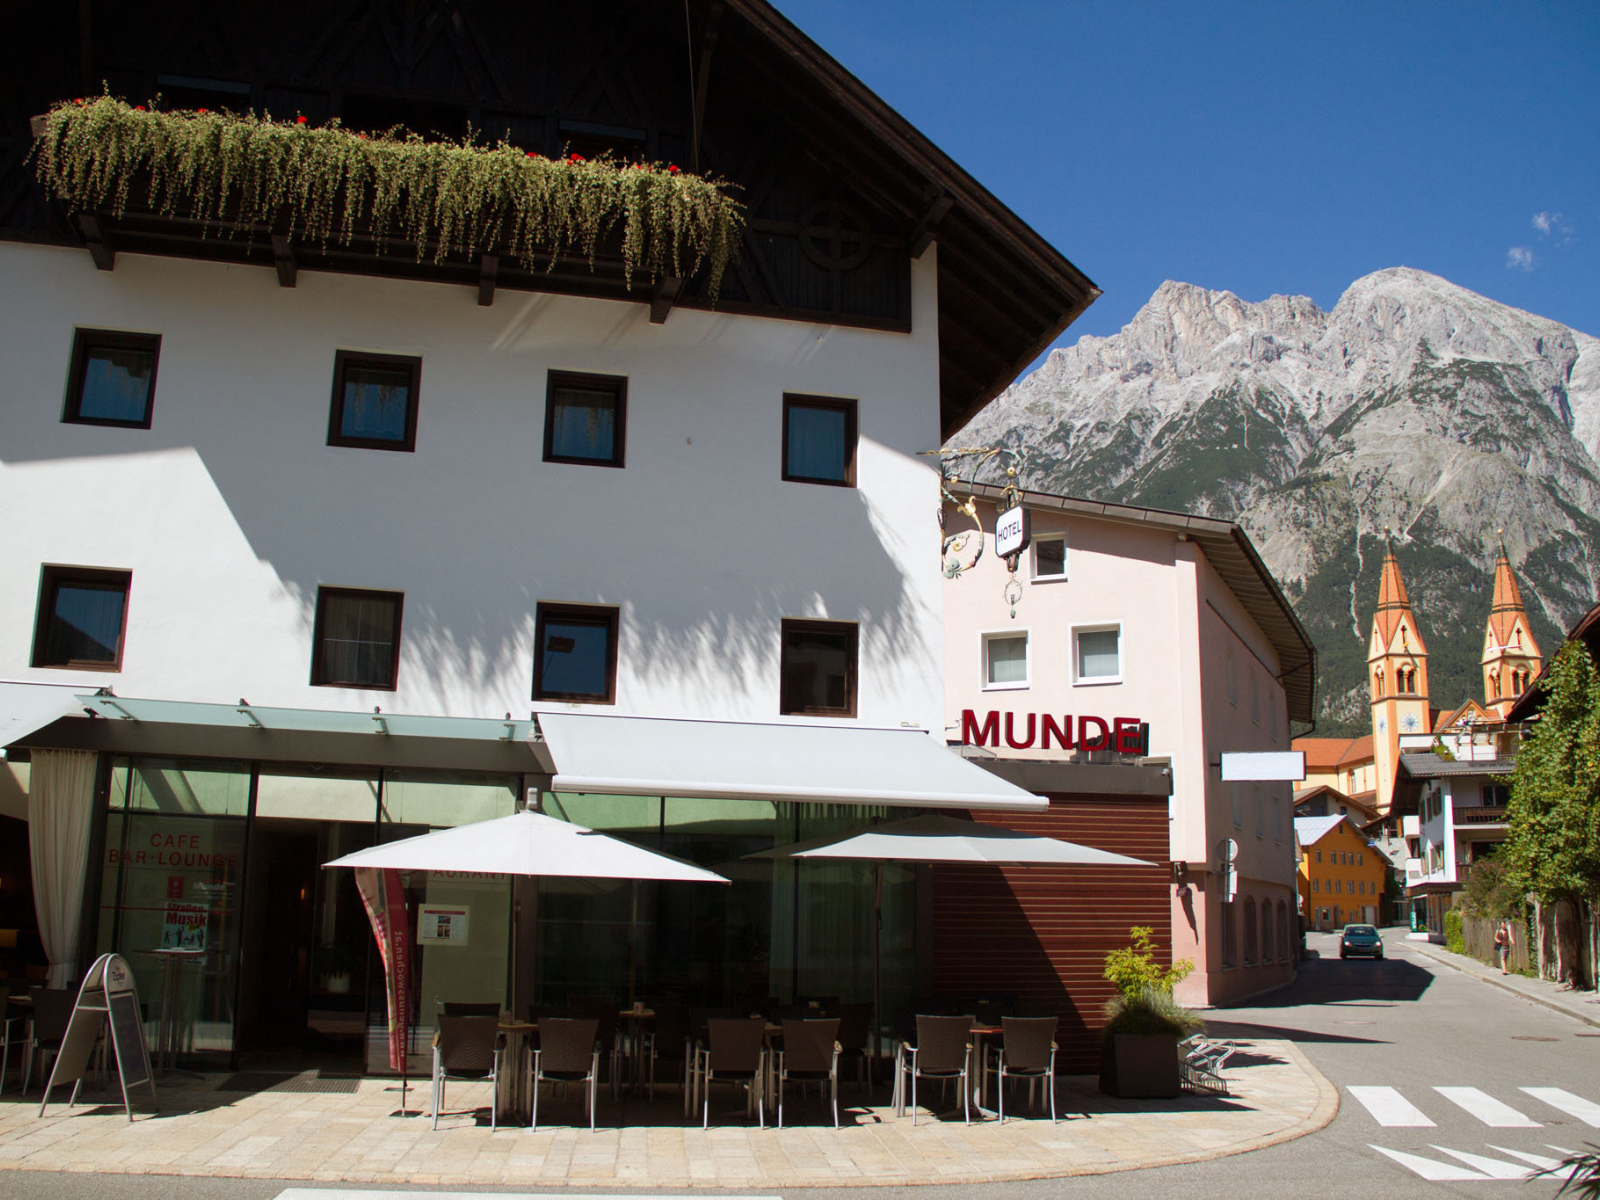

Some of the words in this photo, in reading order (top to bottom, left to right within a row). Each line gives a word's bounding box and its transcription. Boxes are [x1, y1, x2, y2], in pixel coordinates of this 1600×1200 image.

[998, 520, 1022, 543] HOTEL
[962, 709, 1142, 754] MUNDE
[150, 833, 201, 849] CAFE
[166, 911, 207, 926] Musik
